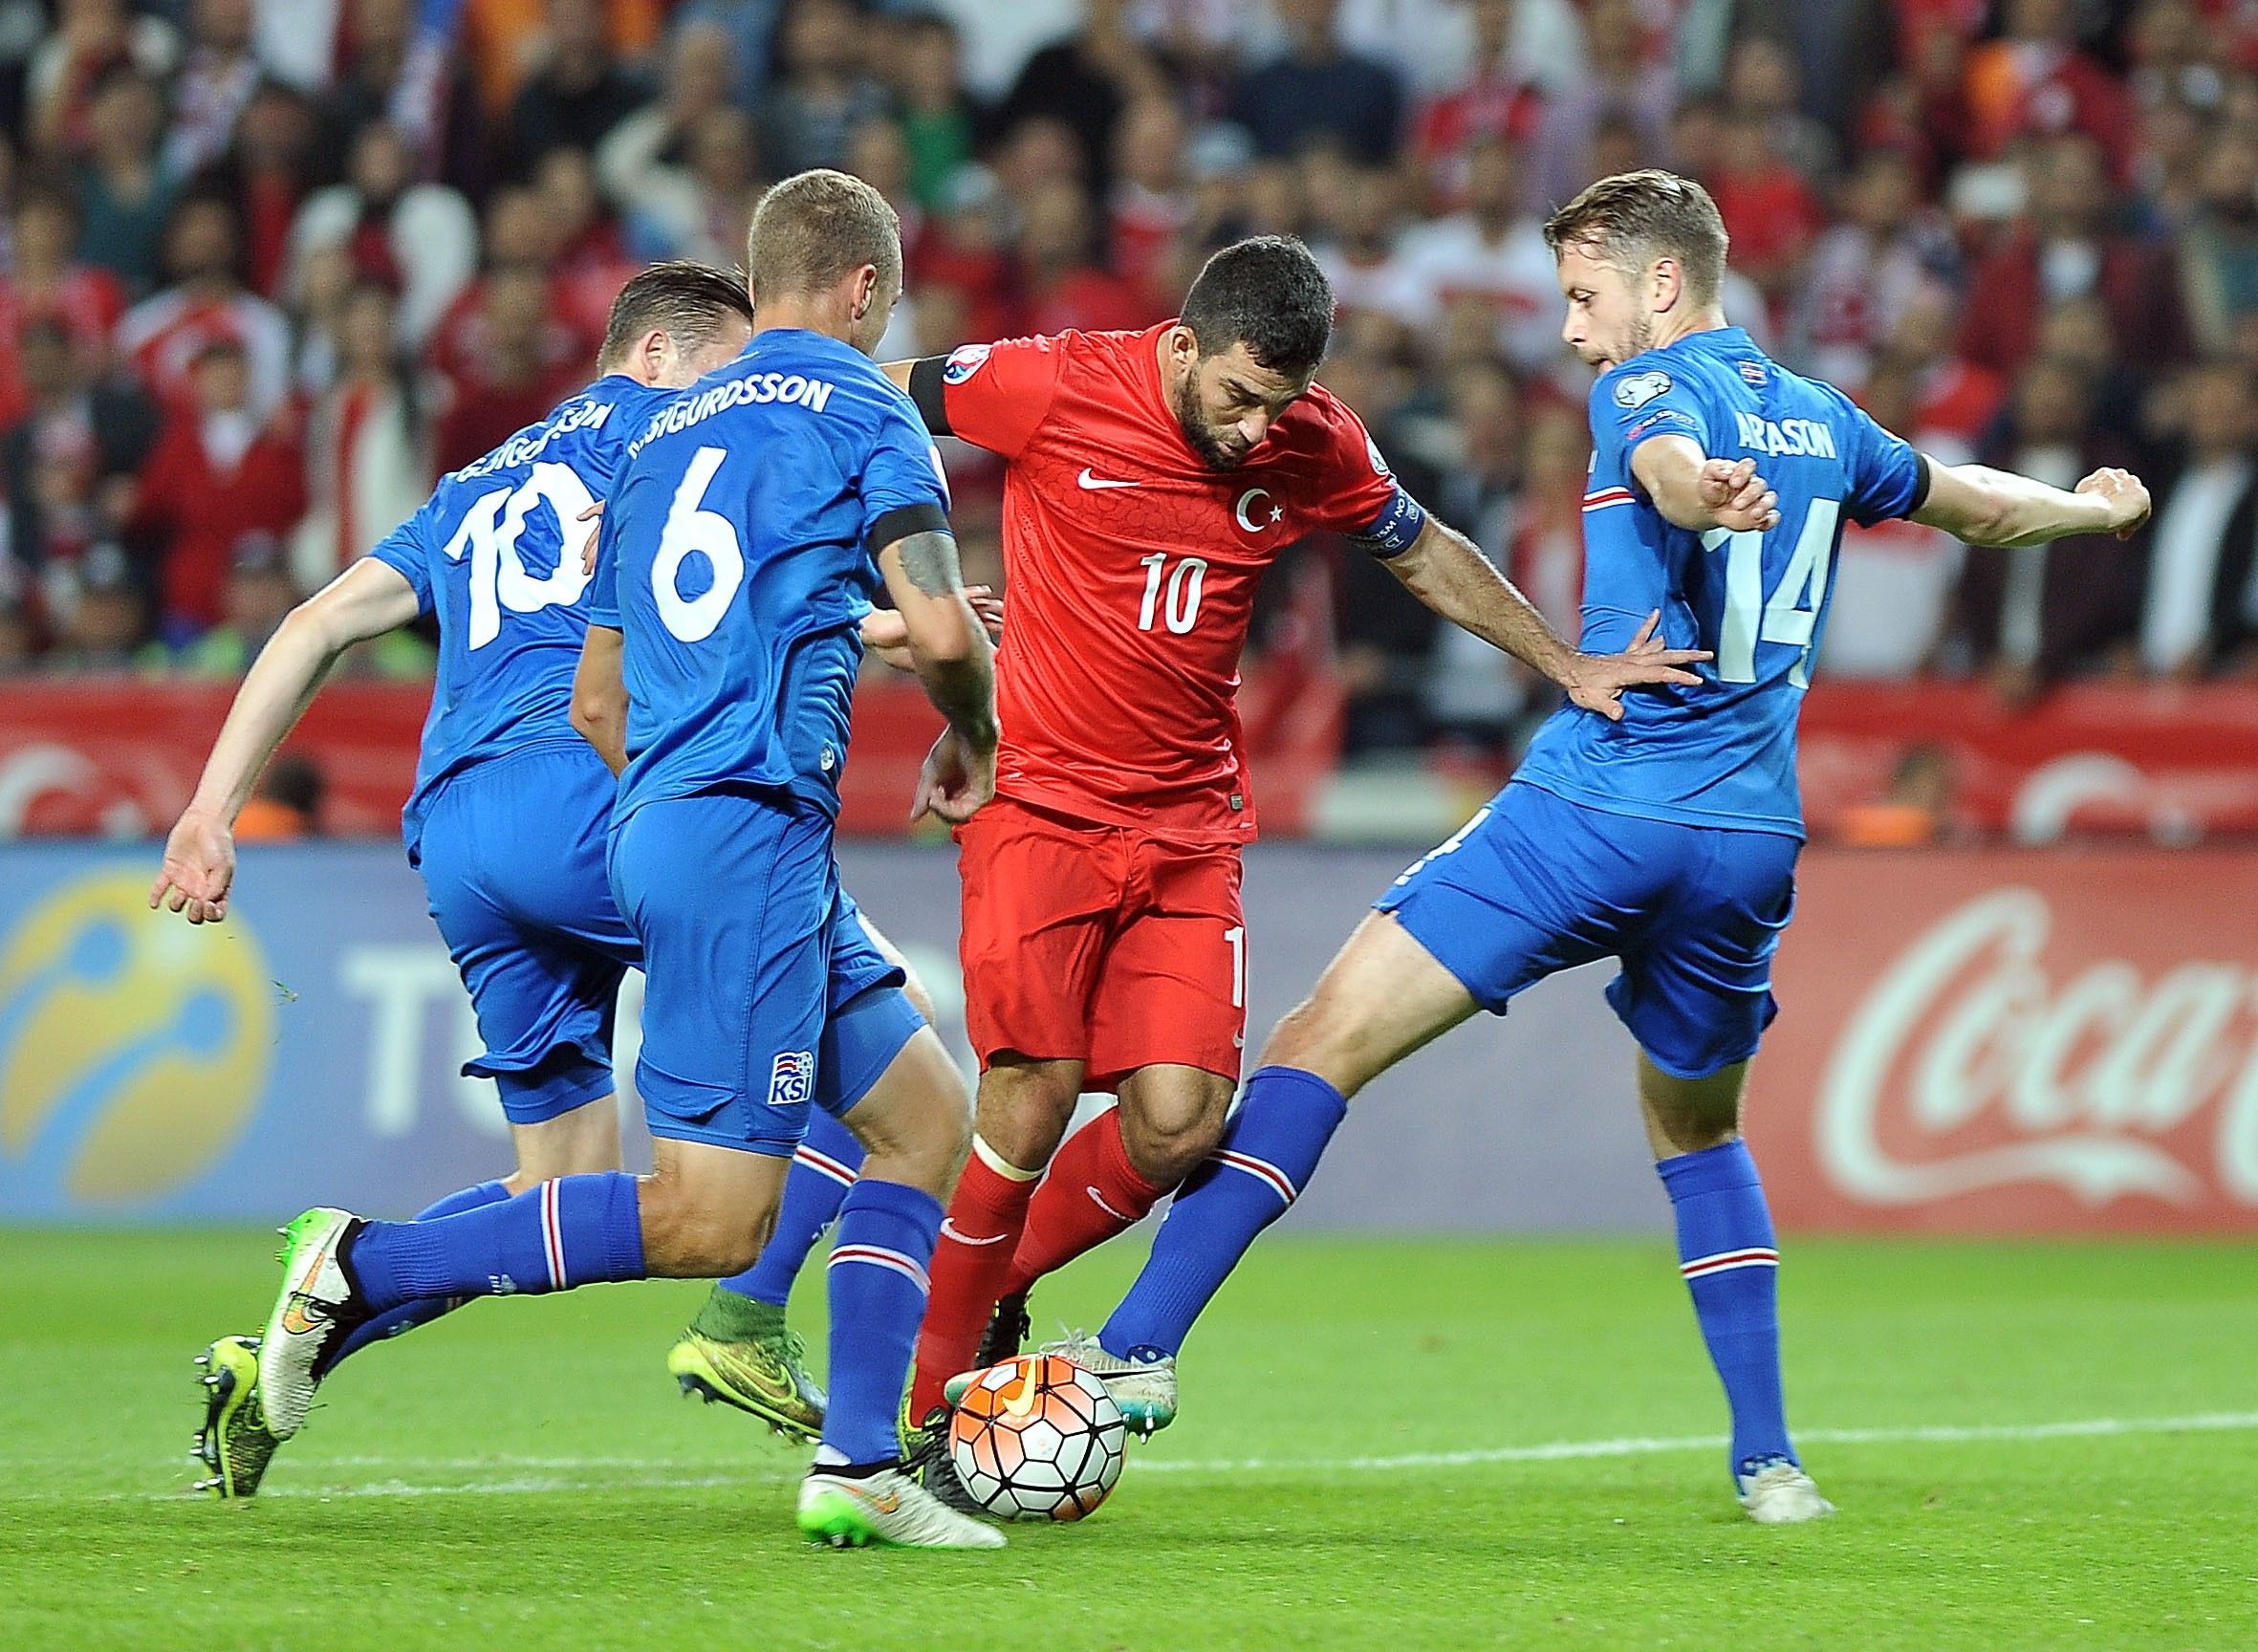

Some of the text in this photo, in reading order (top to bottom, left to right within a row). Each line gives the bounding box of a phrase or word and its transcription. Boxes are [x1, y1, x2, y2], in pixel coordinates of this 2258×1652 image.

[1735, 411, 1837, 459] ARASON
[444, 462, 601, 651] 10
[651, 446, 744, 642] 6
[1137, 552, 1208, 635] 10
[1699, 497, 1840, 689] 14
[771, 1076, 811, 1101] KSI
